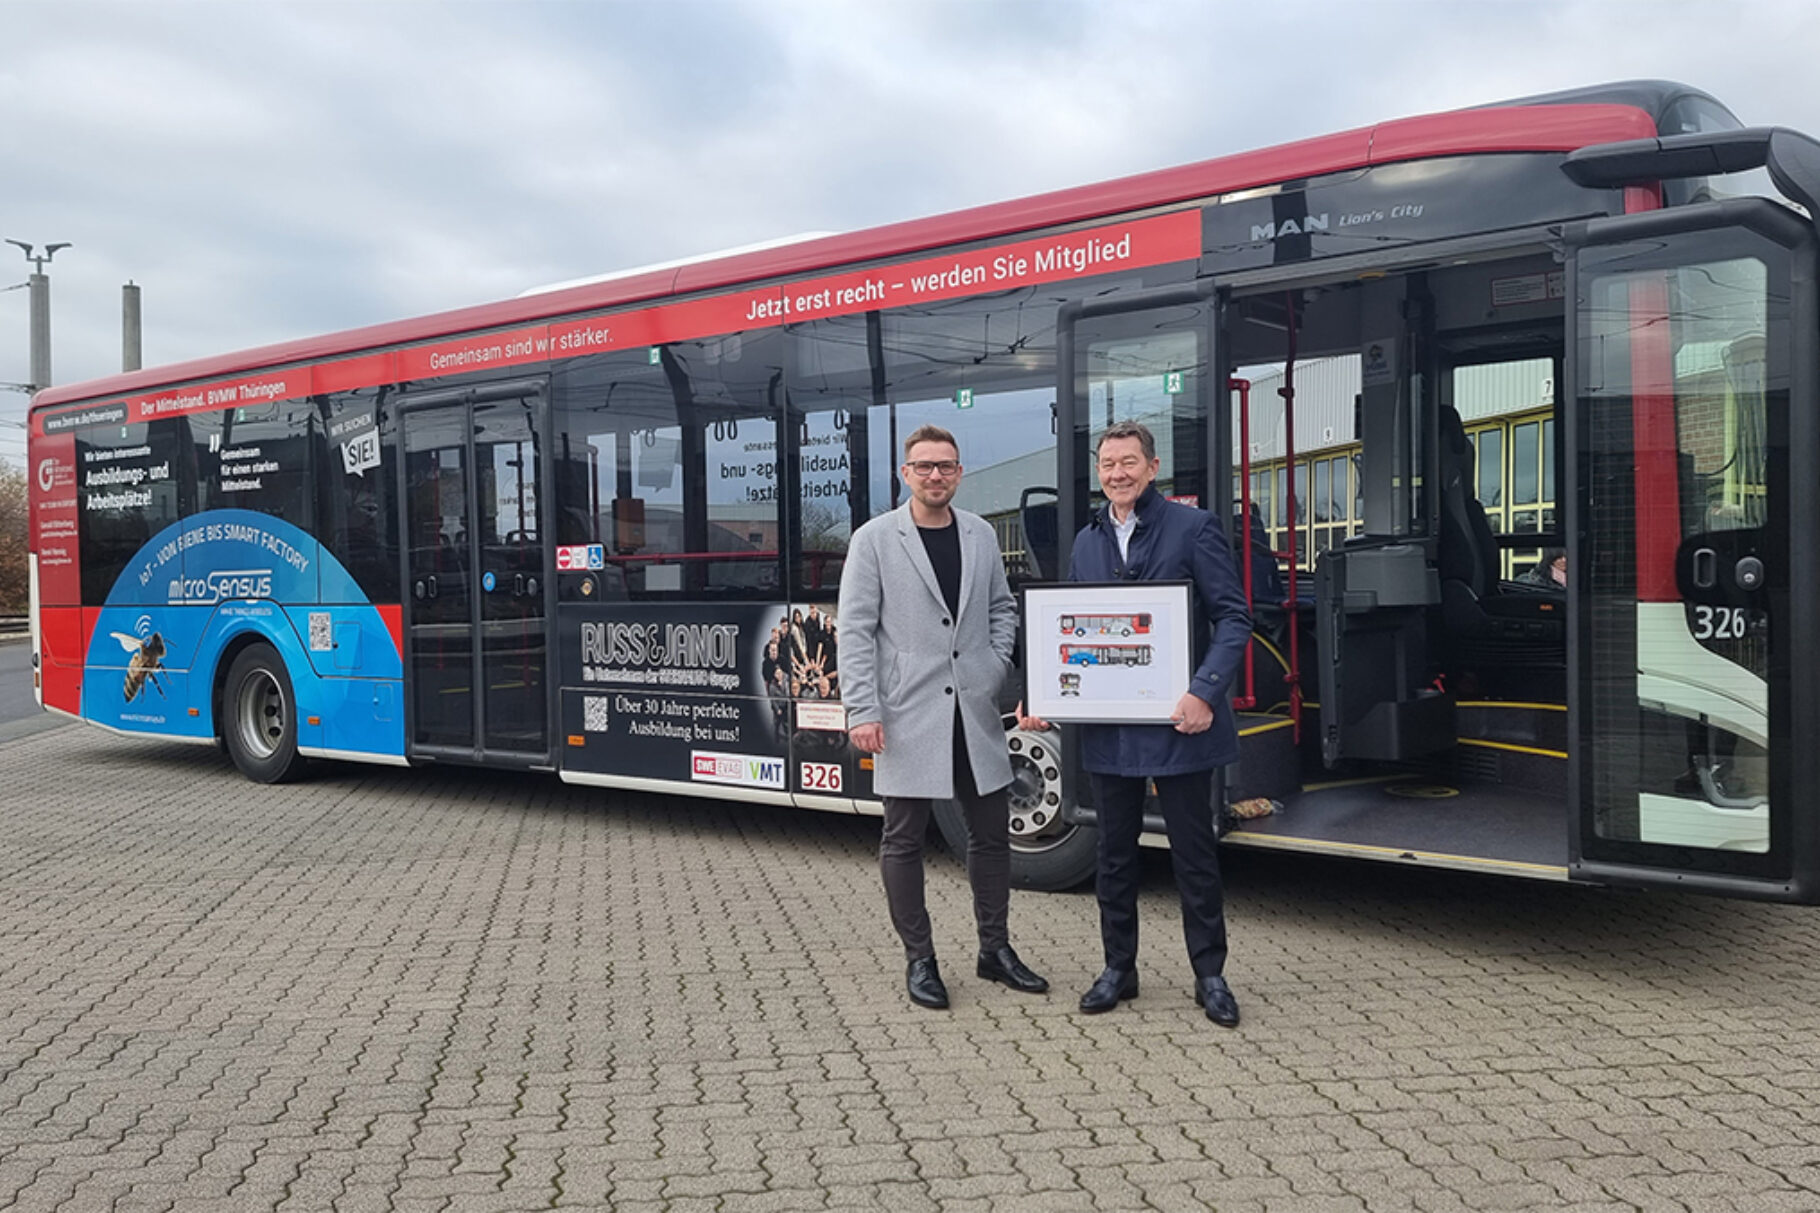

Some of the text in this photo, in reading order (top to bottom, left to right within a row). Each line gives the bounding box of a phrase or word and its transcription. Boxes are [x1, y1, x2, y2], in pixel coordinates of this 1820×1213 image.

[1251, 204, 1424, 242] MAN Lion's City
[746, 294, 790, 321] Jetzt
[795, 286, 831, 311] erst
[836, 280, 885, 308] recht
[911, 261, 987, 294] werden
[993, 253, 1028, 280] Sie
[1034, 233, 1131, 274] Mitglied
[430, 328, 615, 371] Gemeinsam sind wir stärker.
[141, 402, 156, 416] Der
[208, 386, 238, 405] BVMW
[239, 381, 286, 399] Thüringen
[349, 438, 374, 467] SIE!
[85, 465, 147, 486] Ausbildungs-
[149, 460, 169, 480] und
[157, 540, 178, 565] VON
[206, 523, 223, 541] BIS
[224, 523, 260, 544] SMART
[261, 531, 310, 573] FACTORY
[1695, 605, 1745, 640] 326
[615, 694, 740, 721] Über 30 Jahre perfekte
[629, 719, 741, 742] Ausbildung bei uns!
[749, 761, 782, 782] VMT
[803, 764, 840, 789] 326
